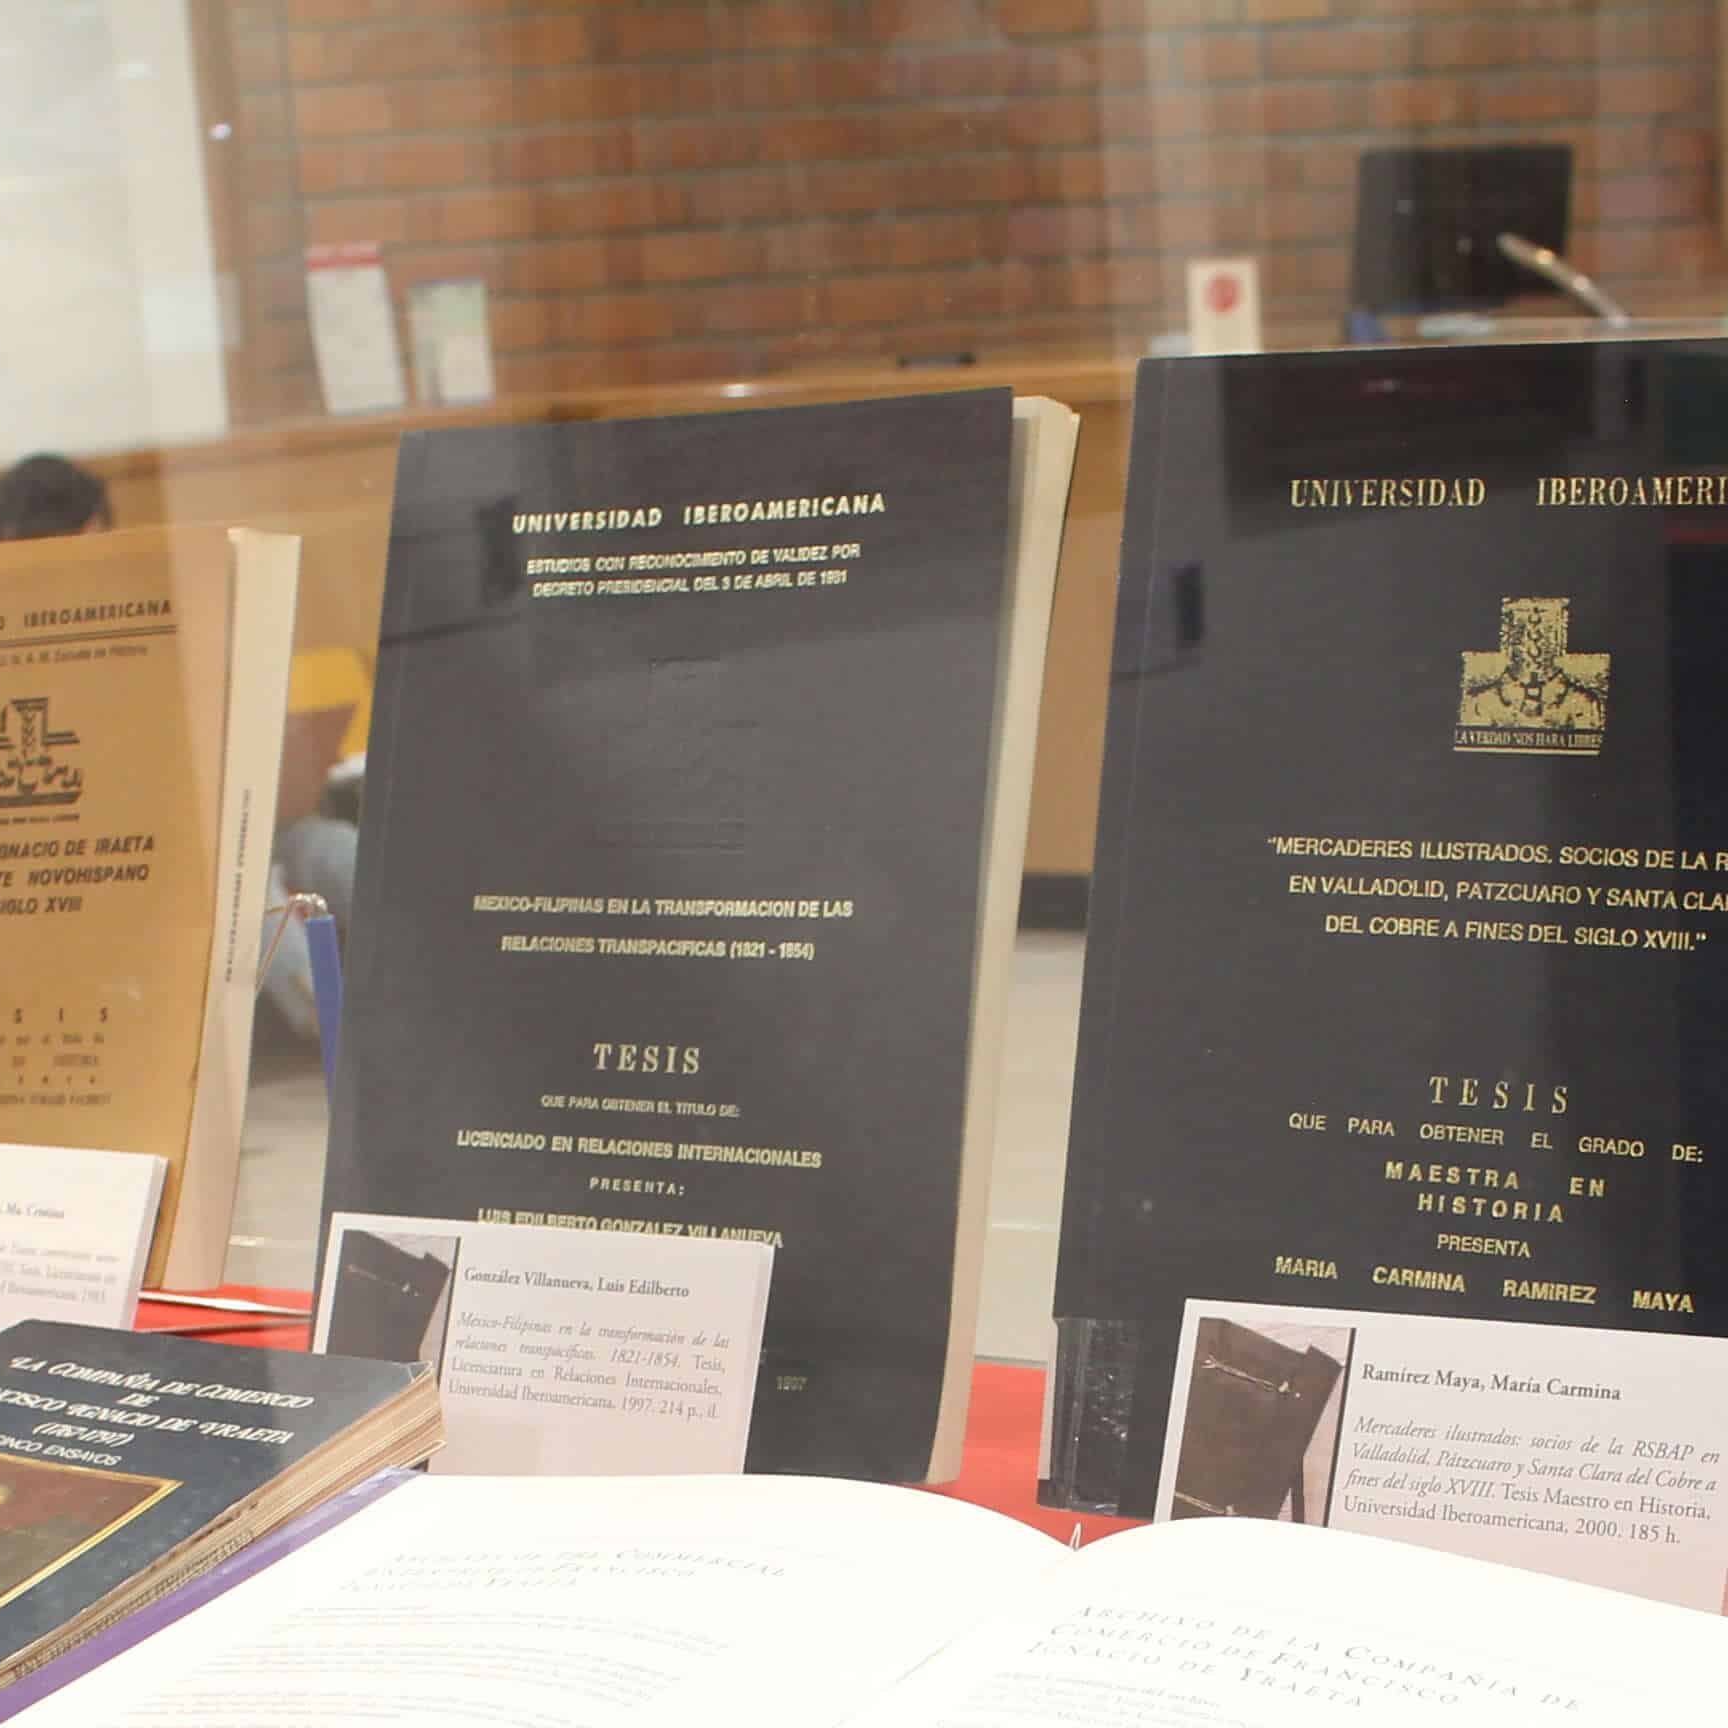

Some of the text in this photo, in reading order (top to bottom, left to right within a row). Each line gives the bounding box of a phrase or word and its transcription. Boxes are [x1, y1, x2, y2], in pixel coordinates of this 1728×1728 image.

[1290, 478, 1485, 507] UNIVERSIDAD
[512, 492, 885, 533] UNIVERSIDAD IBEROAMERICANA
[23, 598, 172, 627] IBEROAMERICANA
[63, 838, 86, 856] DE
[94, 834, 154, 854] IRAETA
[1558, 845, 1638, 867] SOCIOS
[1644, 848, 1674, 869] DE
[1680, 850, 1708, 870] LA
[27, 863, 150, 886] NOVOHISPANO
[606, 897, 628, 914] EN
[630, 898, 650, 915] LA
[654, 899, 795, 917] TRANSFORMACION
[797, 900, 820, 918] DE
[822, 900, 853, 917] LAS
[1288, 874, 1316, 893] EN
[1320, 875, 1448, 901] VALLADOLID,
[1455, 880, 1581, 904] PATZCUARO
[1586, 886, 1602, 905] Y
[1605, 887, 1678, 909] SANTA
[1324, 914, 1363, 933] DEL
[1368, 916, 1440, 936] COBRE
[1443, 920, 1458, 937] A
[1464, 920, 1523, 941] FINES
[1527, 923, 1568, 944] DEL
[1573, 926, 1638, 947] SIGLO
[500, 935, 594, 953] RELACIONES
[597, 937, 726, 957] TRANSPACIFICAS
[729, 940, 765, 959] (1821
[778, 941, 814, 960] 1854)
[592, 1042, 699, 1074] TESIS
[1428, 1075, 1567, 1113] TESIS
[456, 1129, 822, 1168] LICENCIADO EN RELACIONES INTERNACIONALES
[1288, 1111, 1703, 1163] QUE PARA OBTENER EL GRADO DE:
[588, 1176, 684, 1196] PRESENTA:
[1384, 1160, 1604, 1197] MAESTRA EN
[1416, 1193, 1562, 1223] HISTORIA
[1436, 1233, 1530, 1258] PRESENTA
[464, 1267, 520, 1285] González
[596, 1276, 624, 1292] Luis
[628, 1278, 690, 1297] Edilberto
[1274, 1255, 1694, 1313] MARIA CARMINA RAMIREZ MAYA
[9, 1356, 47, 1372] LA
[157, 1379, 198, 1395] DE
[197, 1384, 315, 1409] COMERCIO
[1361, 1363, 1620, 1401] Ramírez Maya, María Carmina
[116, 1392, 160, 1407] DE
[66, 1400, 160, 1426] IGNACIO
[154, 1417, 198, 1431] DE
[198, 1421, 294, 1444] YRAETA
[42, 1444, 122, 1467] ENSAYOS
[1353, 1415, 1437, 1439] Mercaderes
[1529, 1436, 1573, 1451] socios
[1579, 1434, 1600, 1453] de
[1606, 1436, 1624, 1455] la
[1631, 1439, 1695, 1461] RSBAP
[1699, 1451, 1720, 1464] en
[1434, 1449, 1512, 1473] Pátzcuaro
[1511, 1462, 1525, 1479] y
[1526, 1457, 1574, 1478] Santa
[1578, 1462, 1623, 1483] Clara
[1624, 1466, 1653, 1485] del
[1654, 1469, 1703, 1490] Cobre
[1704, 1479, 1717, 1491] a
[1343, 1494, 1436, 1520] Universidad
[1629, 1522, 1660, 1543] 185
[1664, 1524, 1680, 1544] h.
